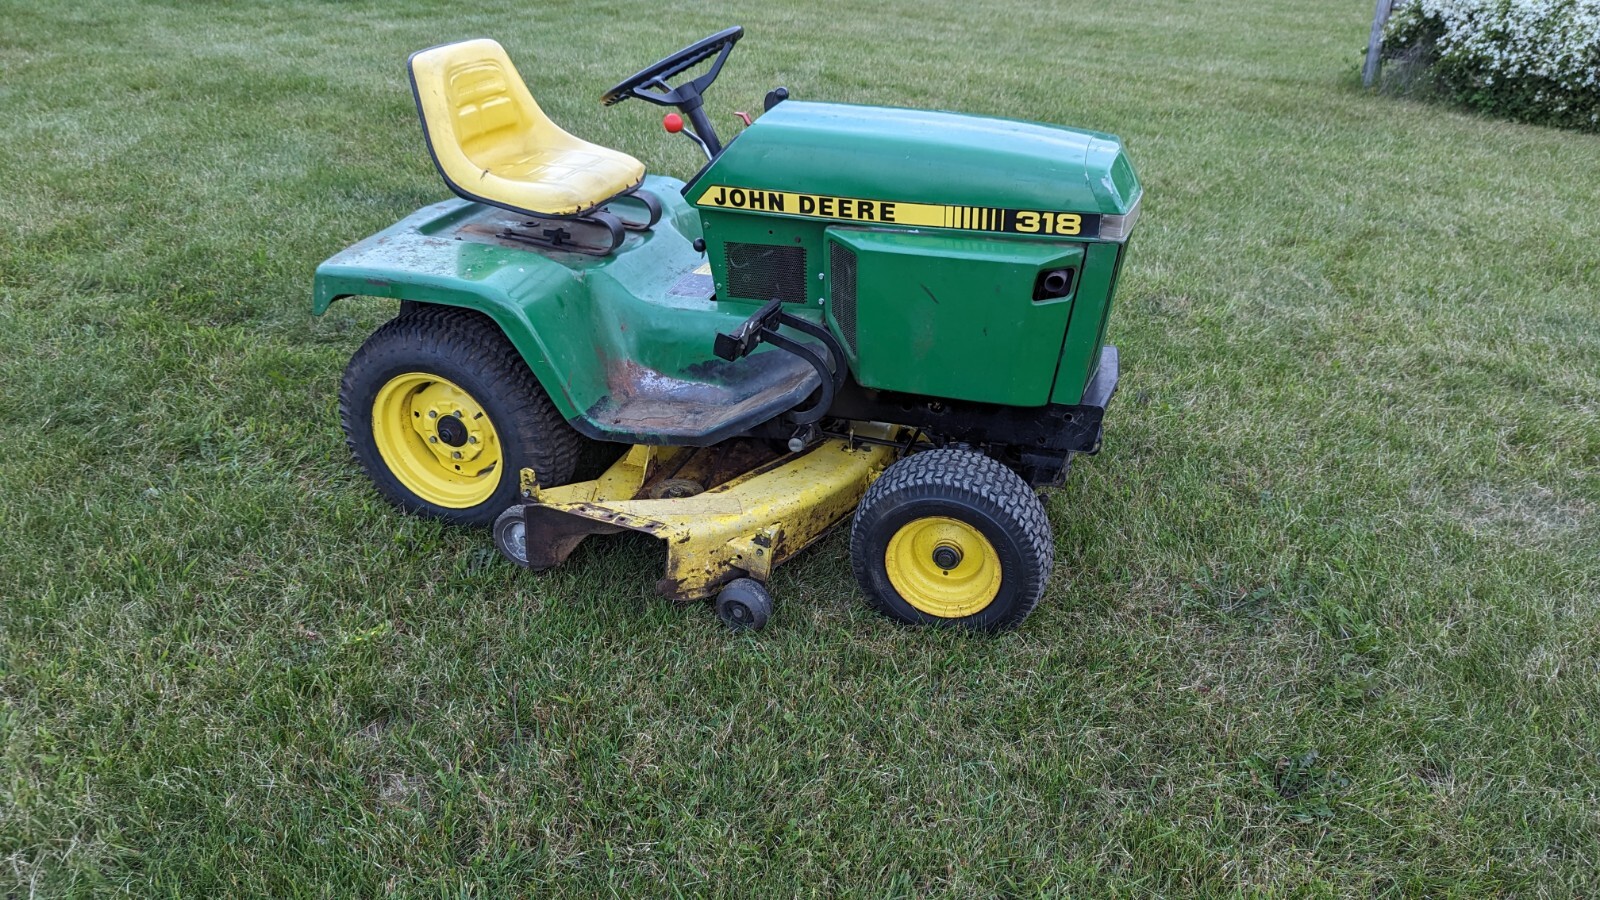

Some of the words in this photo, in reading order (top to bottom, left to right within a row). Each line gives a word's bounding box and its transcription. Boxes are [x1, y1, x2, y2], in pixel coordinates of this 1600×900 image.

[714, 187, 784, 212] JOHN
[798, 195, 896, 222] DEERE
[1015, 211, 1082, 235] 318
